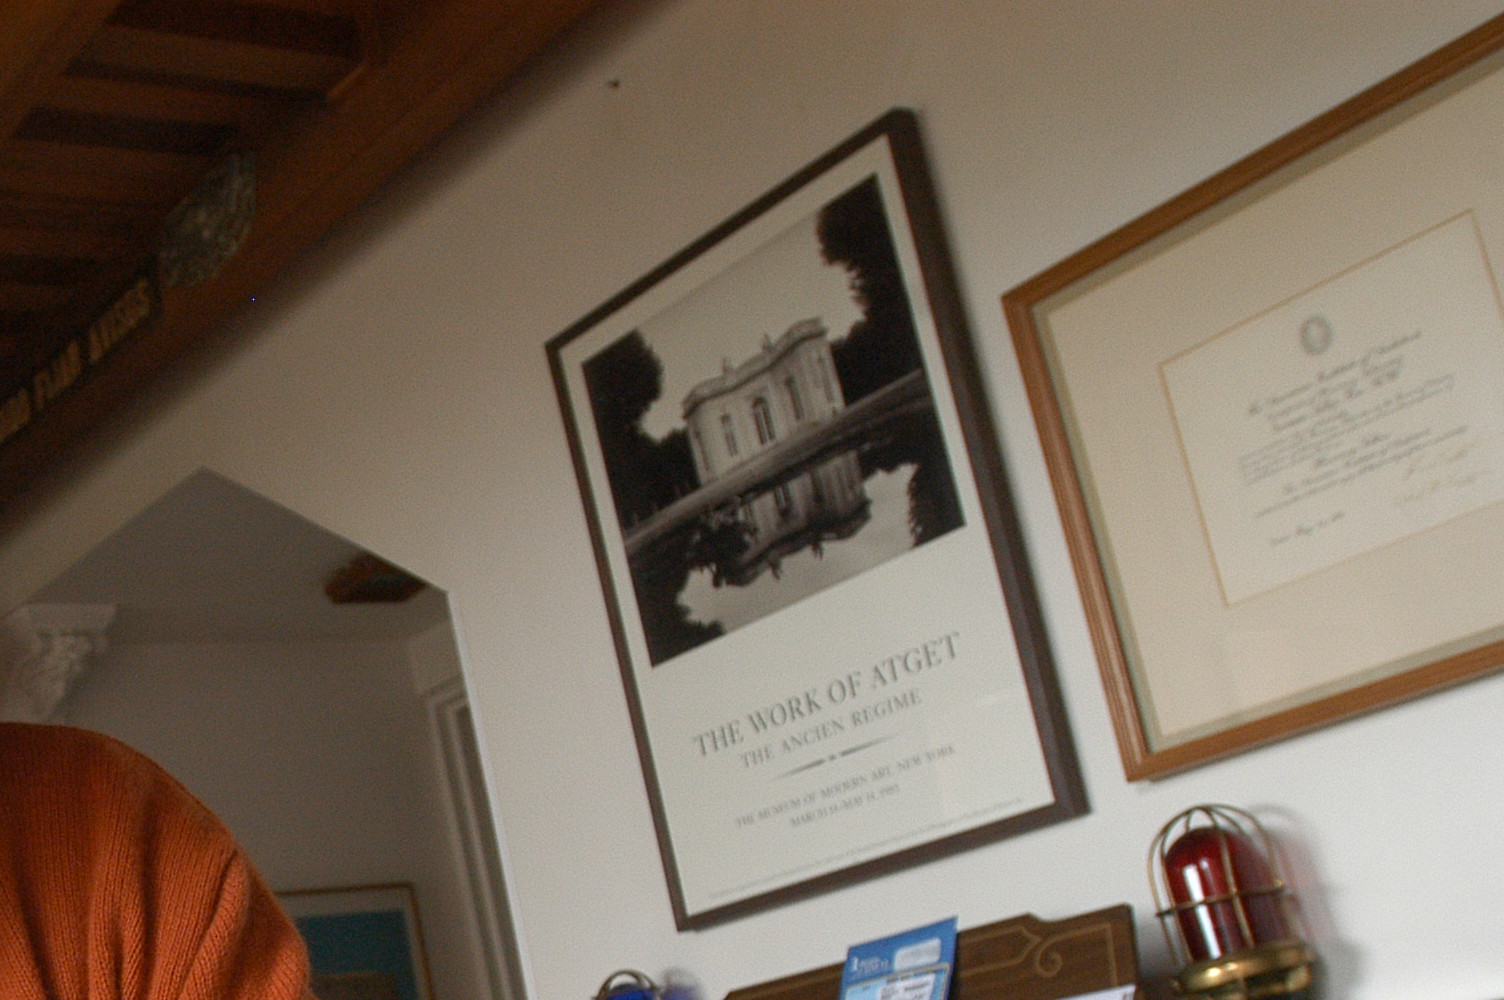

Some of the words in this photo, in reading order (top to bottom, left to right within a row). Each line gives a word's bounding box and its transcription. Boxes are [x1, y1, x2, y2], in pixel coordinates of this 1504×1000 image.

[692, 718, 745, 758] THE
[747, 687, 823, 734] WORK
[827, 670, 862, 704] OF
[869, 630, 960, 690] ATGET
[740, 744, 774, 768] THE
[780, 719, 846, 754] ANCIEN
[758, 797, 801, 820] MUSEUM
[821, 775, 868, 799] MODERN
[896, 755, 922, 772] NEW
[925, 744, 956, 761] YORK
